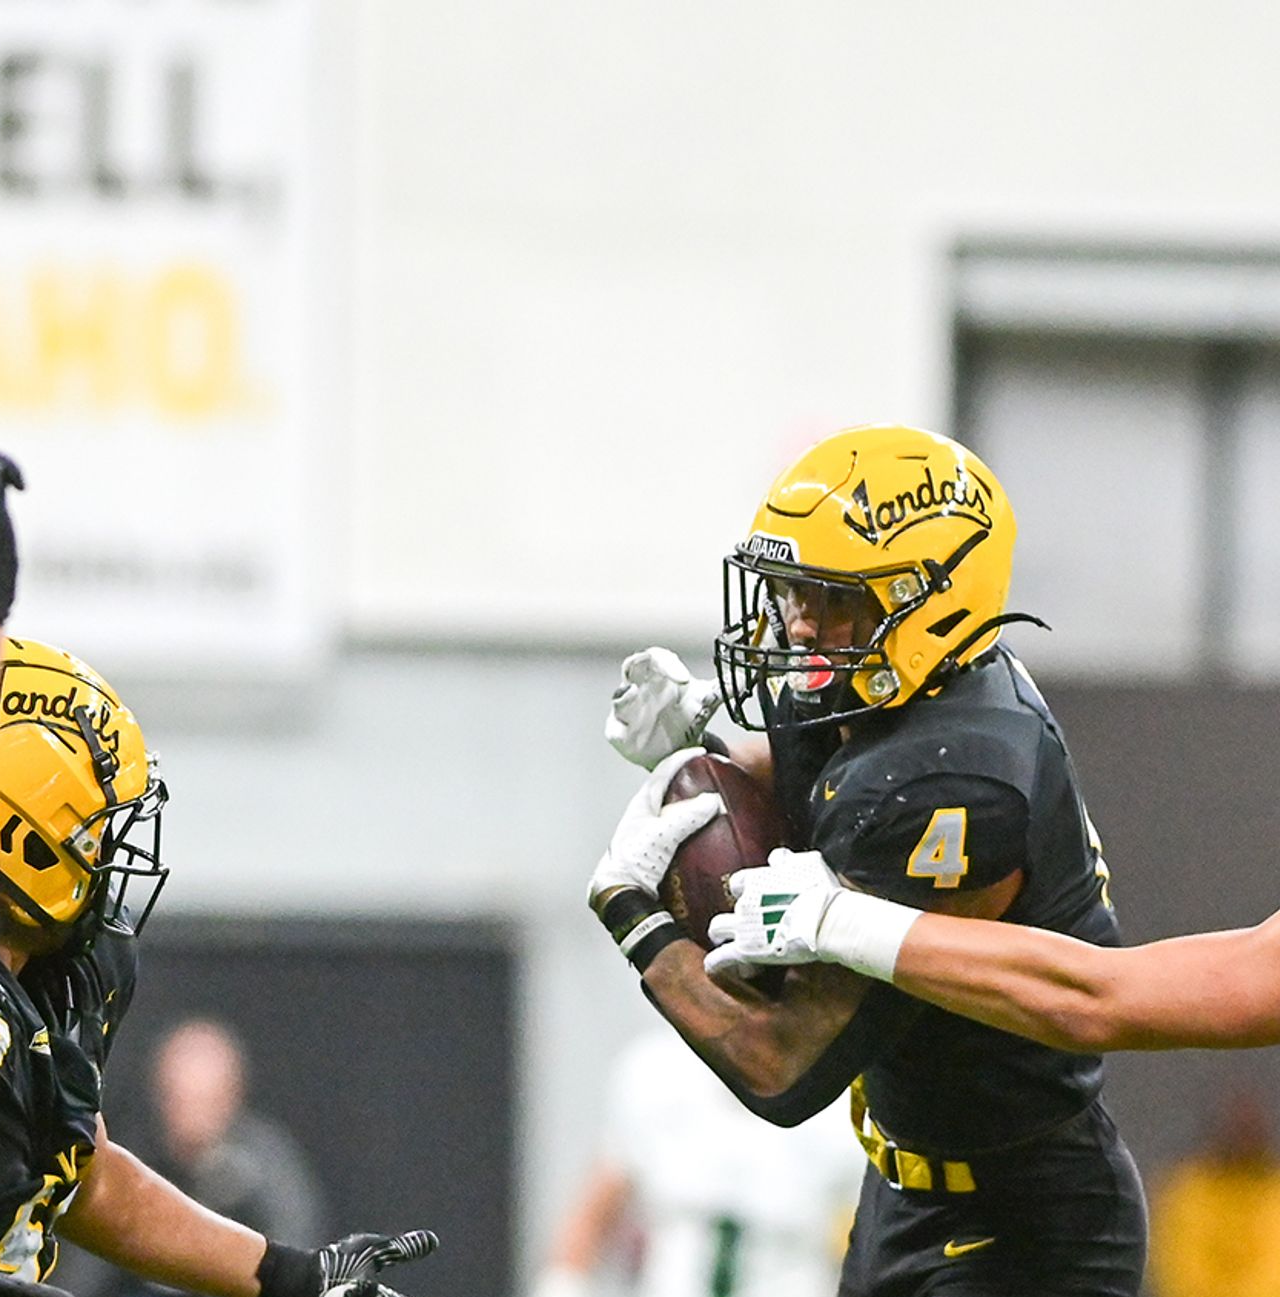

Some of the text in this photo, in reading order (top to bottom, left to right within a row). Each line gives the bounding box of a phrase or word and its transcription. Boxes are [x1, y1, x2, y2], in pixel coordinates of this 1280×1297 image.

[843, 465, 993, 547] Vandals
[749, 537, 790, 562] IDAHO
[906, 806, 969, 888] 4
